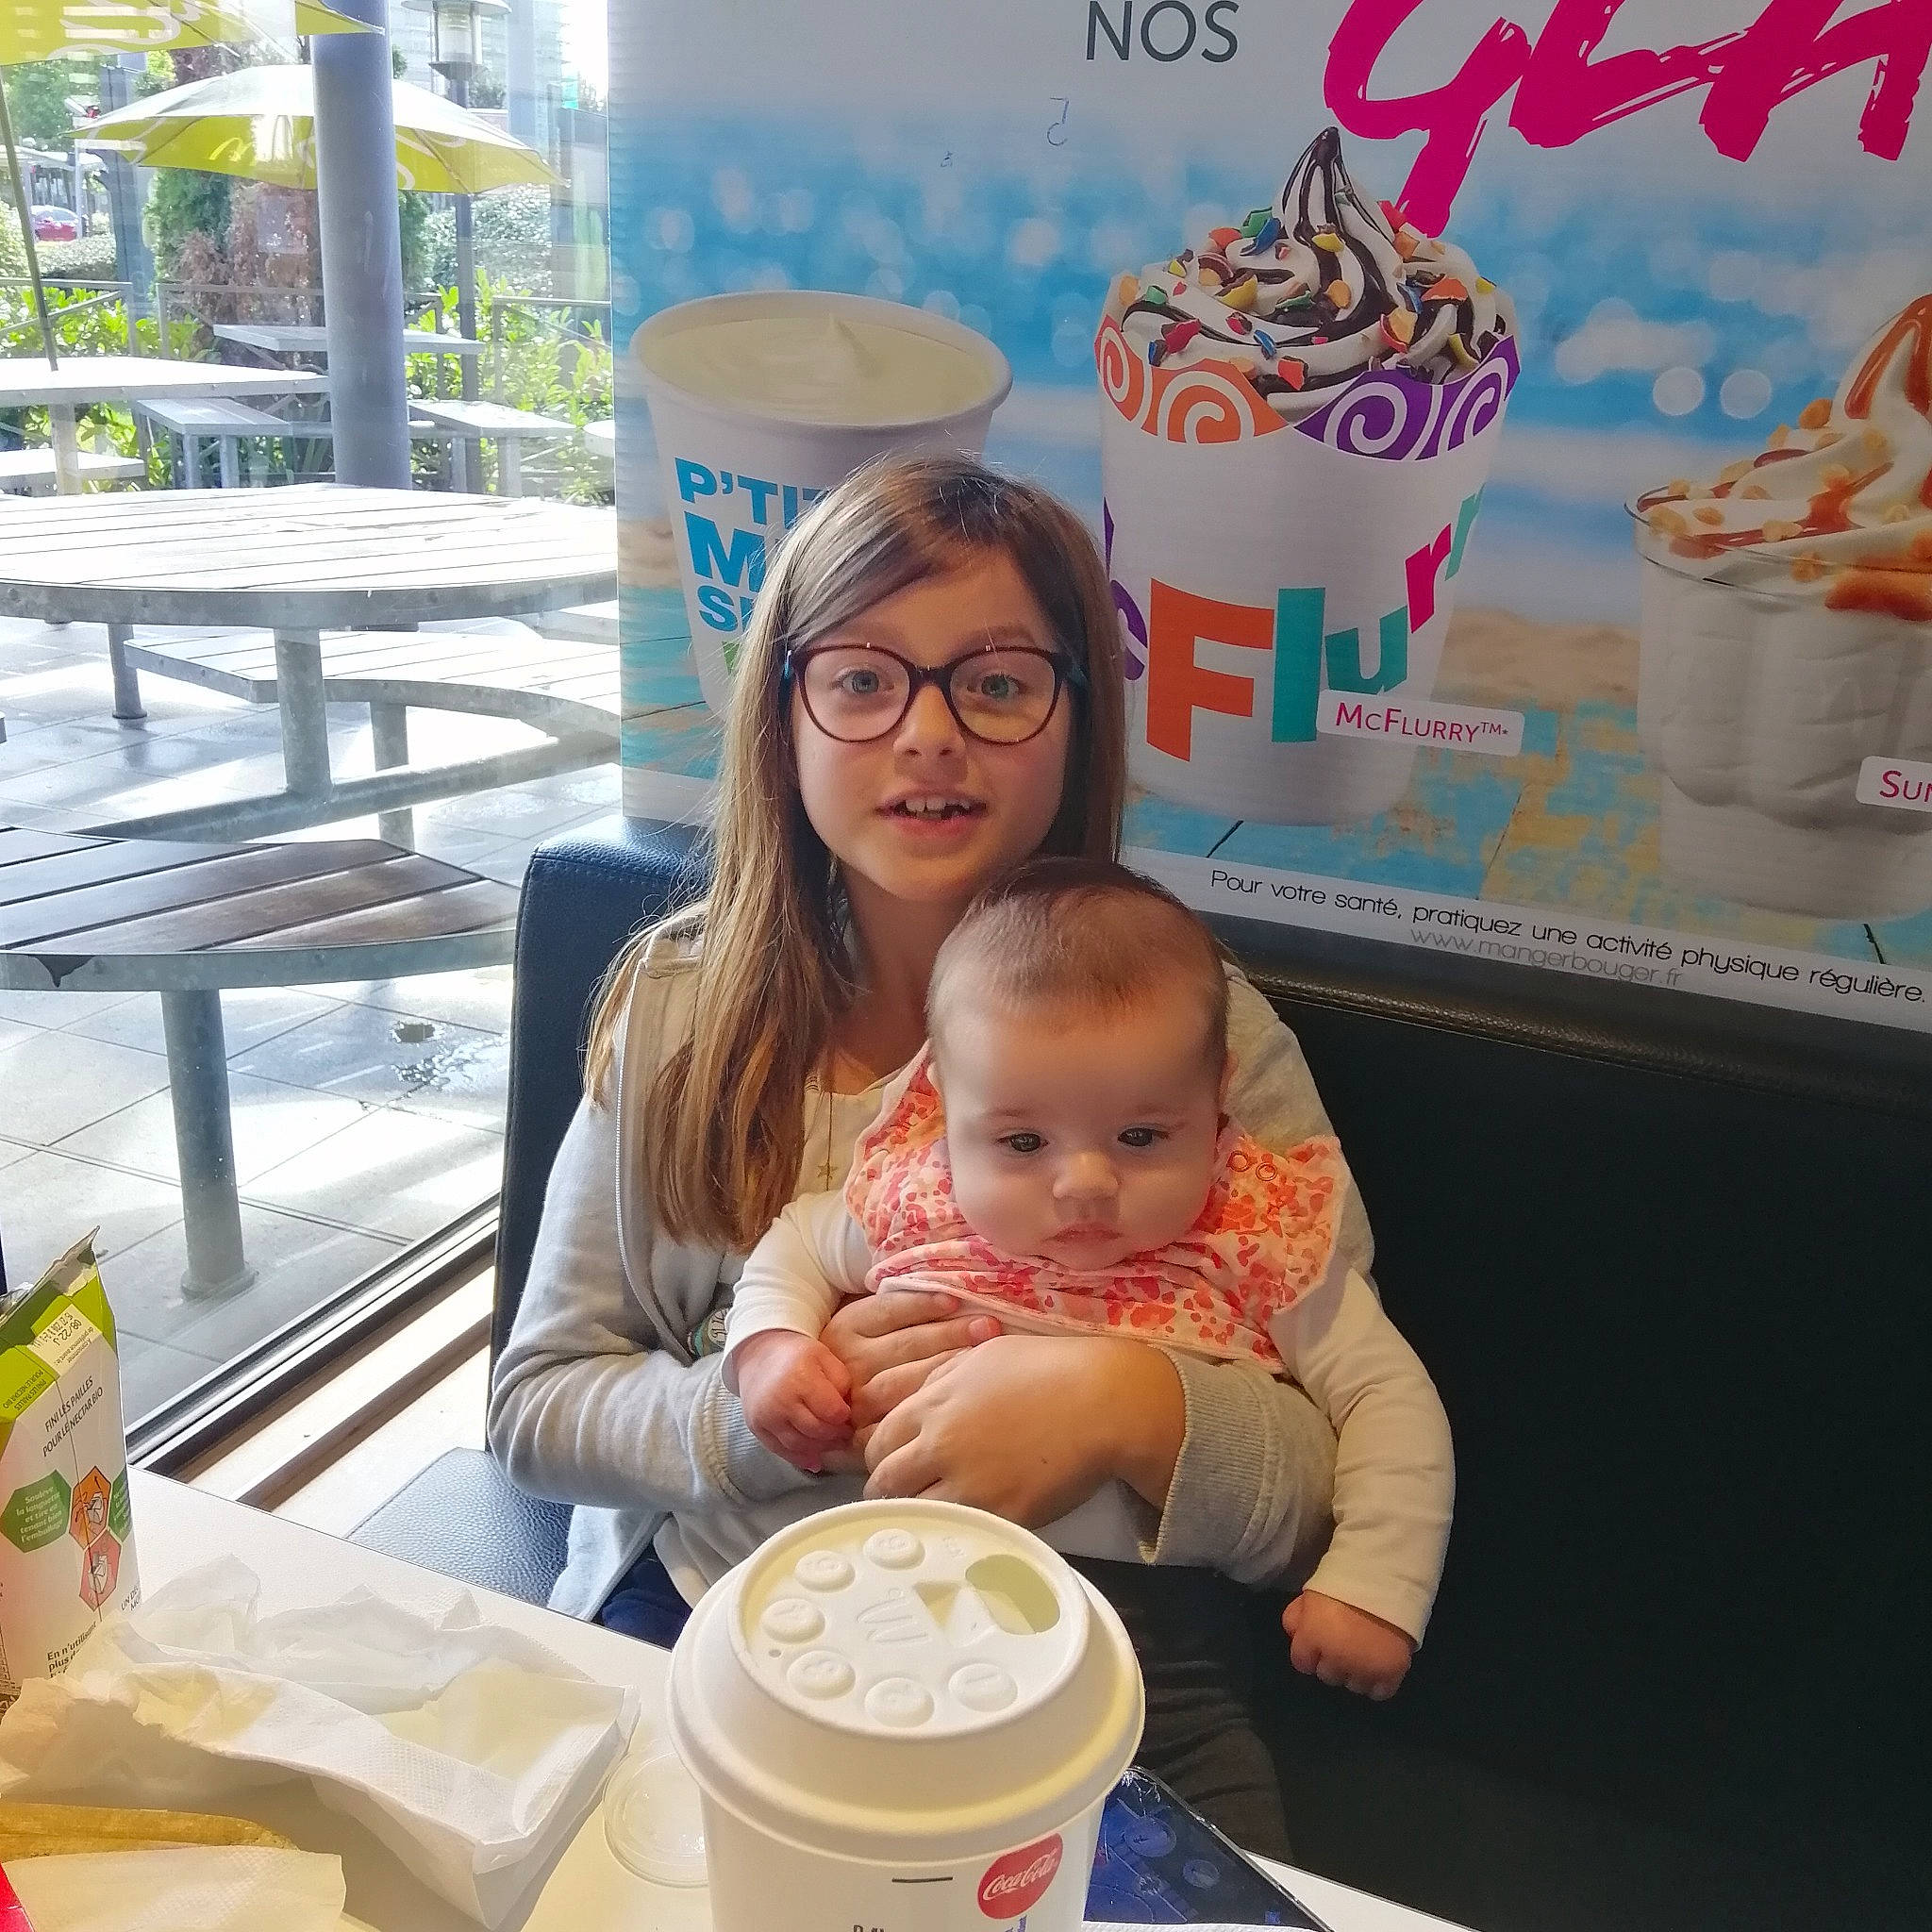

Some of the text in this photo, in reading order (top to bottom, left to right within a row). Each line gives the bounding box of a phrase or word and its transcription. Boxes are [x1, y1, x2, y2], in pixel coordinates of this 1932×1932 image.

[1087, 0, 1240, 62] NOS
[1210, 869, 1925, 1003] Pour votre santé, pratiquez une activité physique régulière.
[1410, 928, 1684, 988] www.mangerbouger.fr
[42, 1386, 104, 1457] POUR LE NECTAR BIO
[44, 1375, 93, 1432] FINI LES PAILLES
[47, 1651, 60, 1661] En
[48, 1657, 69, 1673] plus
